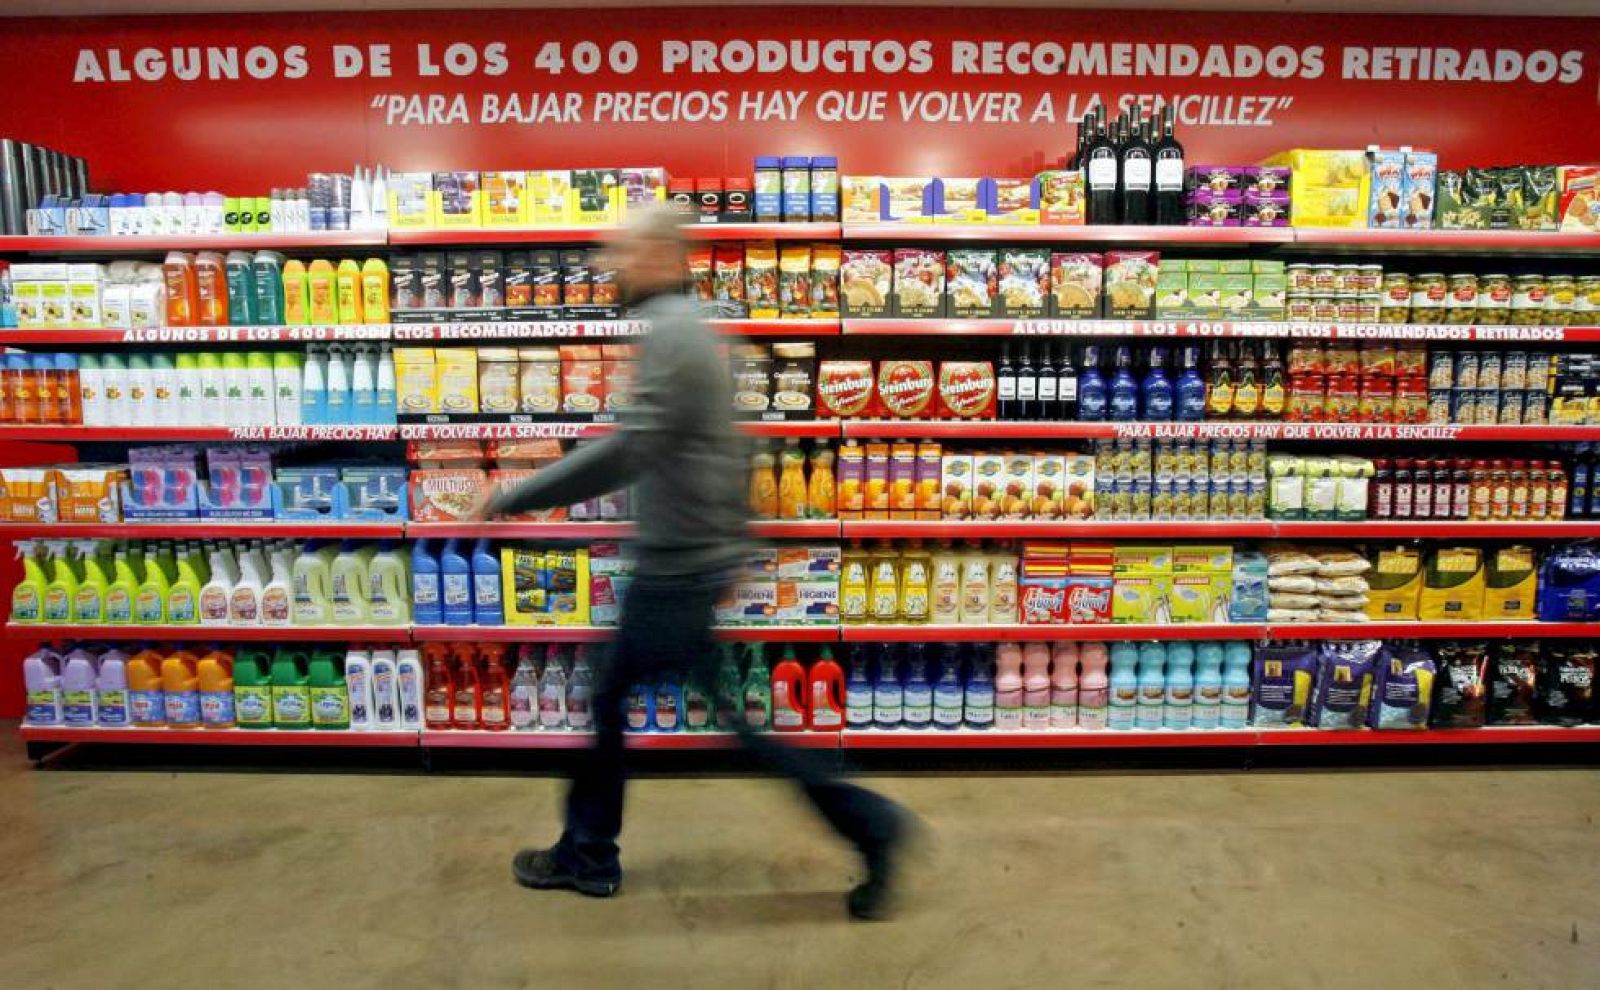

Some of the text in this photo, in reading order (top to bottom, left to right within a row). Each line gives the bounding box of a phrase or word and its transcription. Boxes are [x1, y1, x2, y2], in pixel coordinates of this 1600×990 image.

[73, 40, 1583, 84] ALGUNOS DE LOS 400 PRODUCTOS RECOMENDADOS RETIRADOS
[370, 93, 470, 125] “PARA
[480, 93, 582, 124] BAJAR
[593, 91, 729, 122] PRECIOS
[738, 90, 809, 122] HAY
[815, 90, 887, 122] QUE
[899, 91, 1022, 123] VOLVER
[1029, 92, 1056, 123] A
[1066, 93, 1104, 123] LA
[123, 328, 209, 342] ALGUNOS
[217, 328, 240, 342] DE
[247, 327, 280, 341] LOS
[288, 327, 326, 340] 400
[440, 324, 578, 338] RECOMENDADOS
[1142, 322, 1177, 336] LOS
[1186, 322, 1224, 336] 400
[1232, 323, 1331, 338] PRODUCTOS
[1337, 324, 1470, 339] RECOMENDADOS
[1475, 326, 1564, 341] RETIRADOS
[269, 427, 308, 439] BAJAR
[311, 426, 363, 439] PRECIOS
[401, 425, 428, 439] QUE
[431, 425, 480, 438] VOLVER
[482, 425, 493, 437] A
[496, 425, 513, 437] LA
[1155, 425, 1195, 438] BAJAR
[1198, 425, 1249, 439] PRECIOS
[1253, 426, 1280, 439] HAY
[1283, 426, 1312, 439] QUE
[1315, 426, 1360, 439] VOLVER
[1363, 427, 1374, 439] A
[1377, 427, 1393, 439] LA
